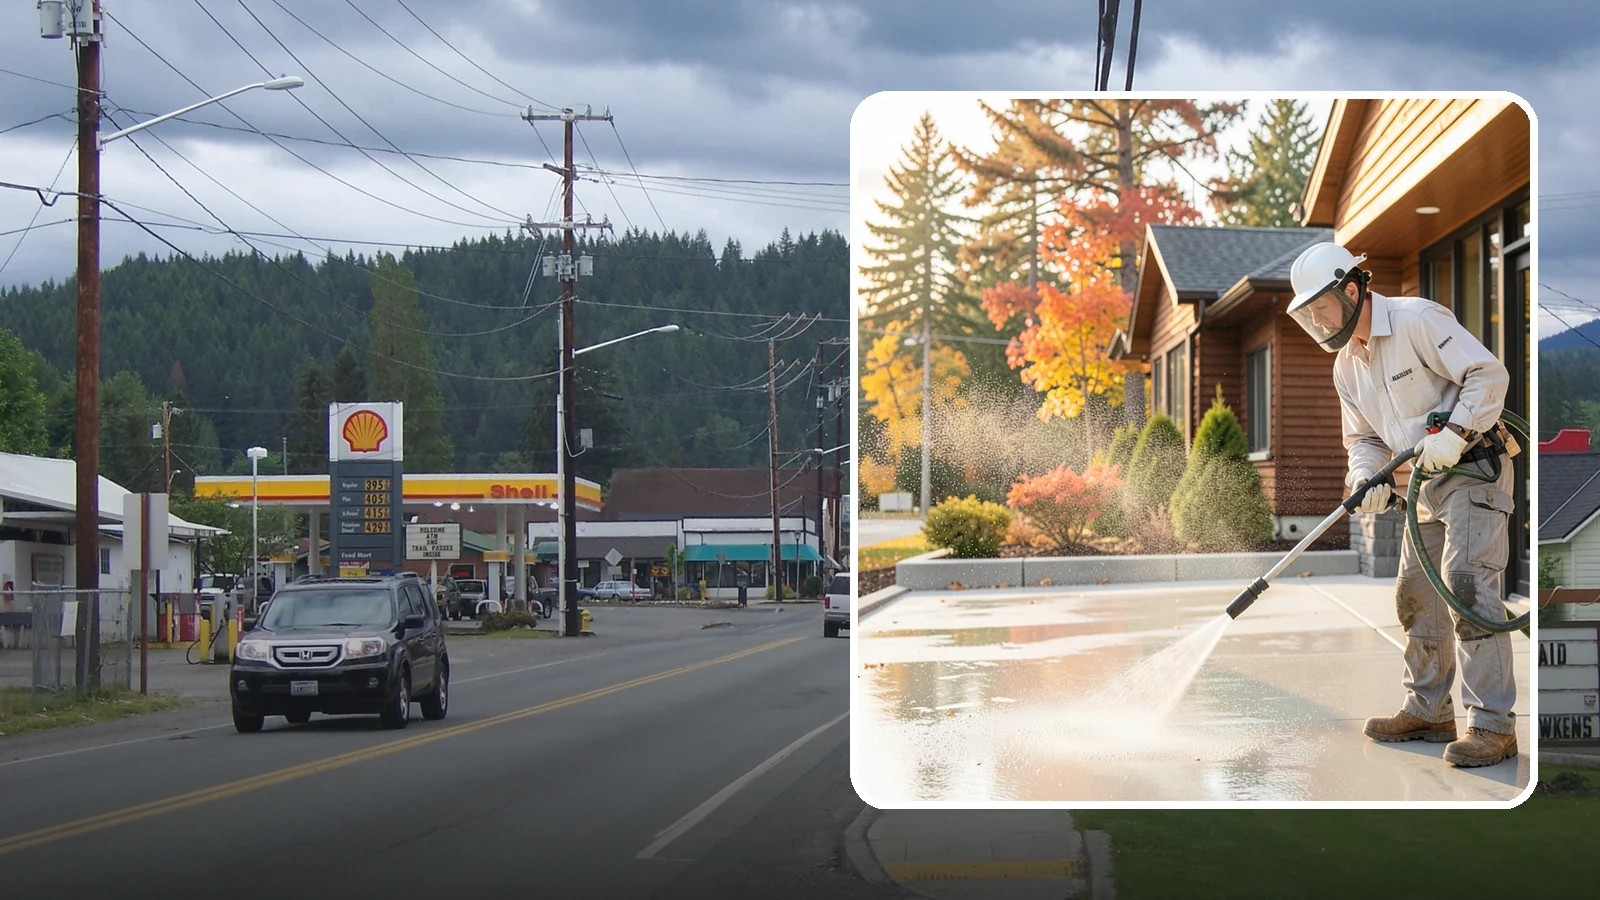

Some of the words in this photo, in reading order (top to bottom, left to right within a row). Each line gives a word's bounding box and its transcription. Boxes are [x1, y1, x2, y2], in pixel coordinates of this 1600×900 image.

[366, 480, 383, 490] 395
[490, 484, 547, 499] Shell
[366, 494, 383, 504] 405
[366, 508, 383, 518] 415
[366, 522, 383, 533] 429
